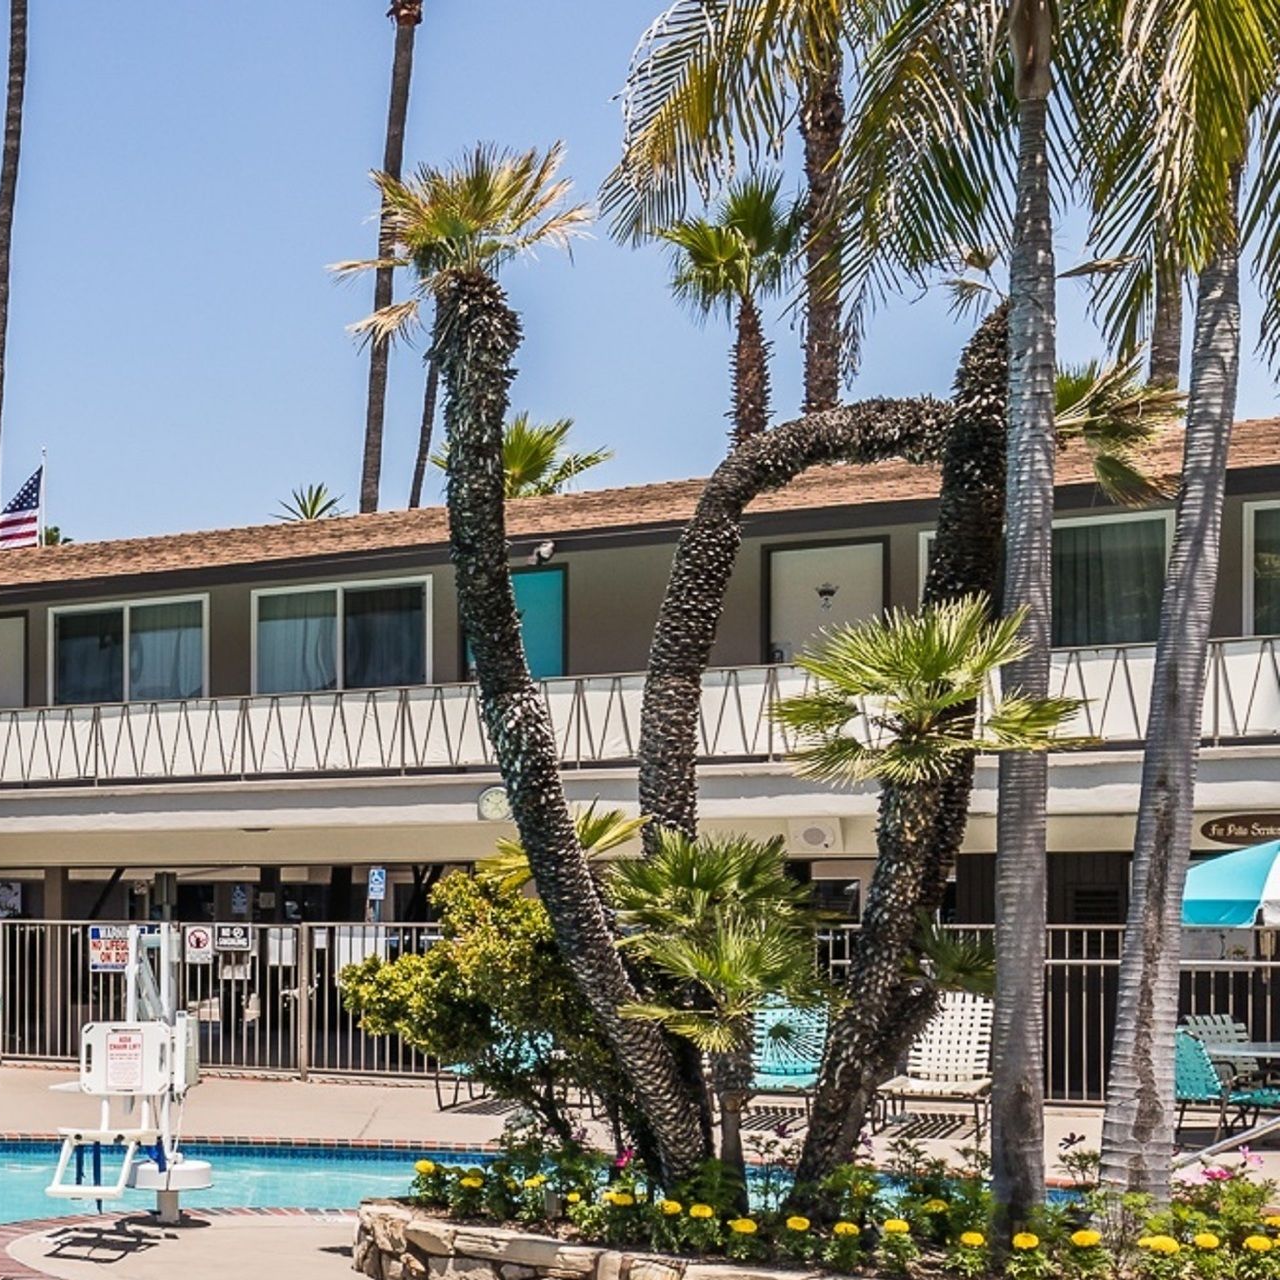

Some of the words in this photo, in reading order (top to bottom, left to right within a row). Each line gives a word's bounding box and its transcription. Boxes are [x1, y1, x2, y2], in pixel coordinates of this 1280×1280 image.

[100, 927, 128, 939] WARNI
[91, 940, 102, 951] NO
[105, 940, 128, 951] LIFEG
[100, 951, 112, 963] ON
[115, 951, 129, 963] DUT
